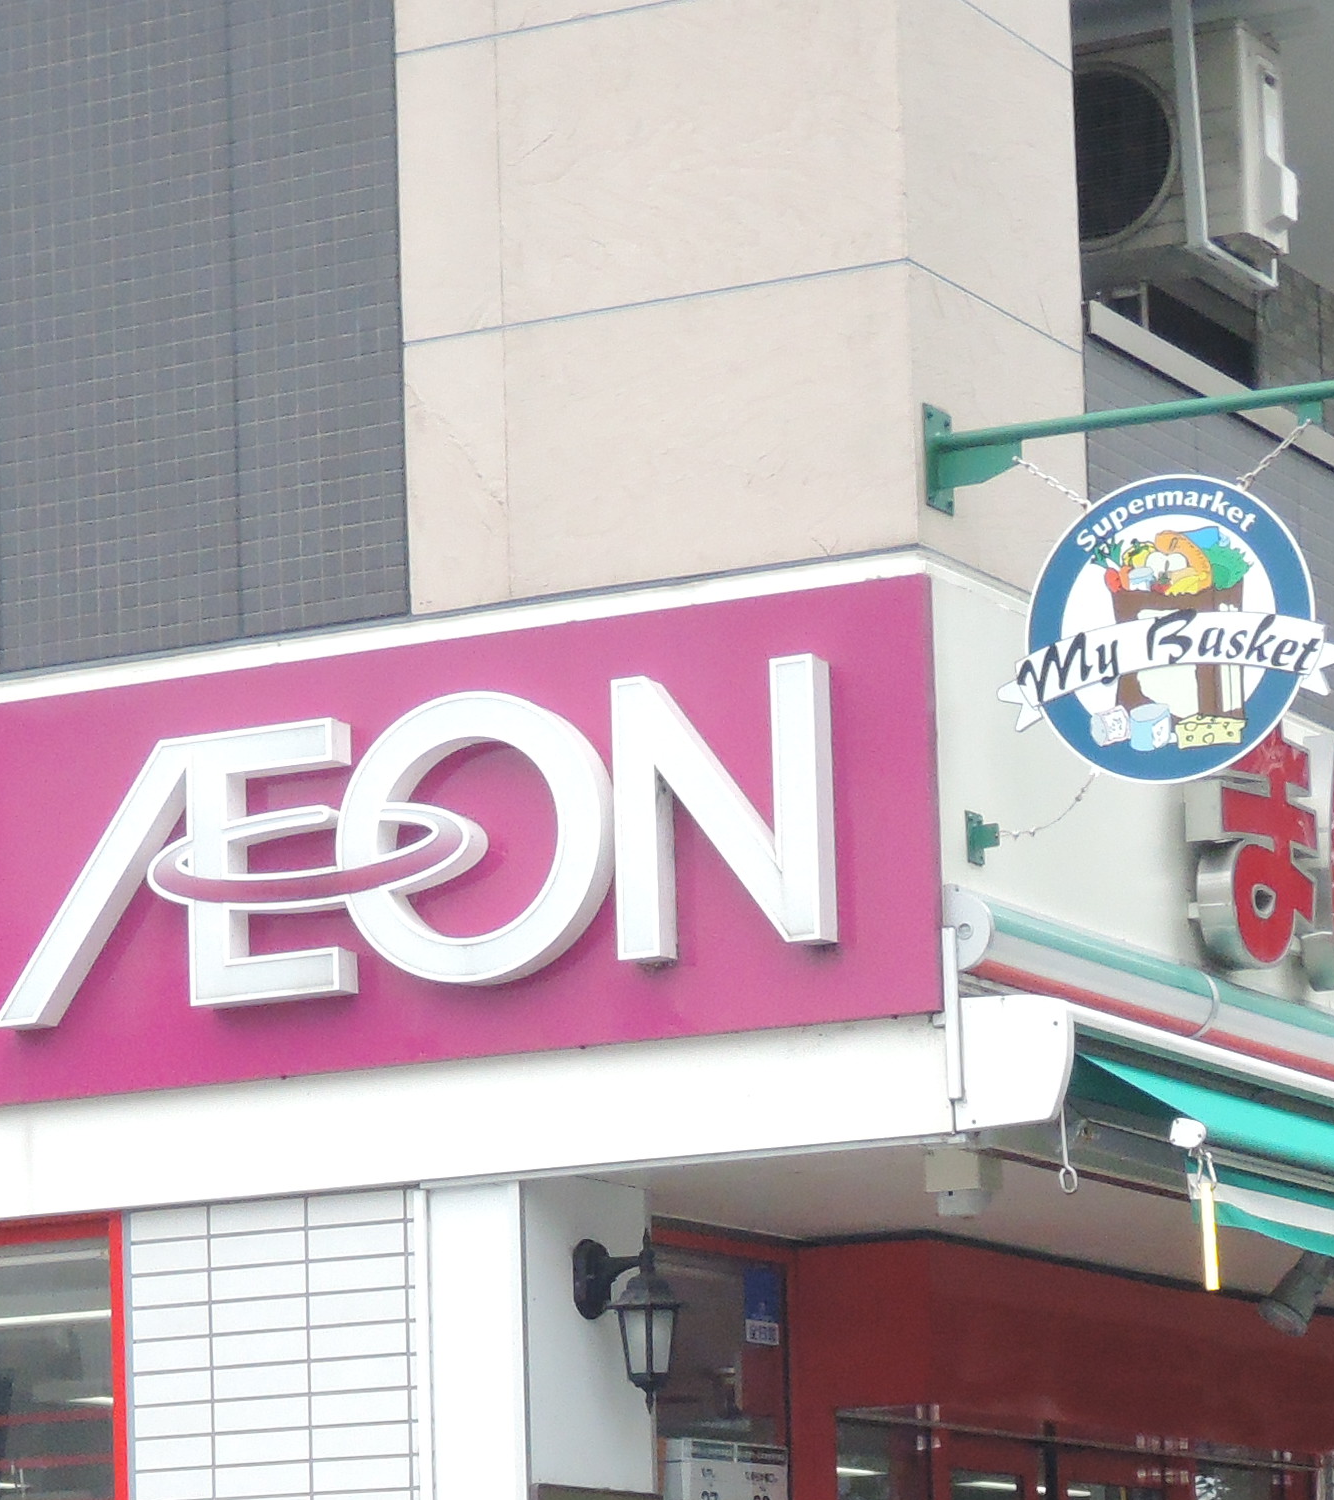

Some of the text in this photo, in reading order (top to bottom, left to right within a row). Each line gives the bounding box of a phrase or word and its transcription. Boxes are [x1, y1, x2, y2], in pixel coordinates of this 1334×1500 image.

[1076, 488, 1257, 553] Supermarket
[1017, 609, 1322, 703] My Basket
